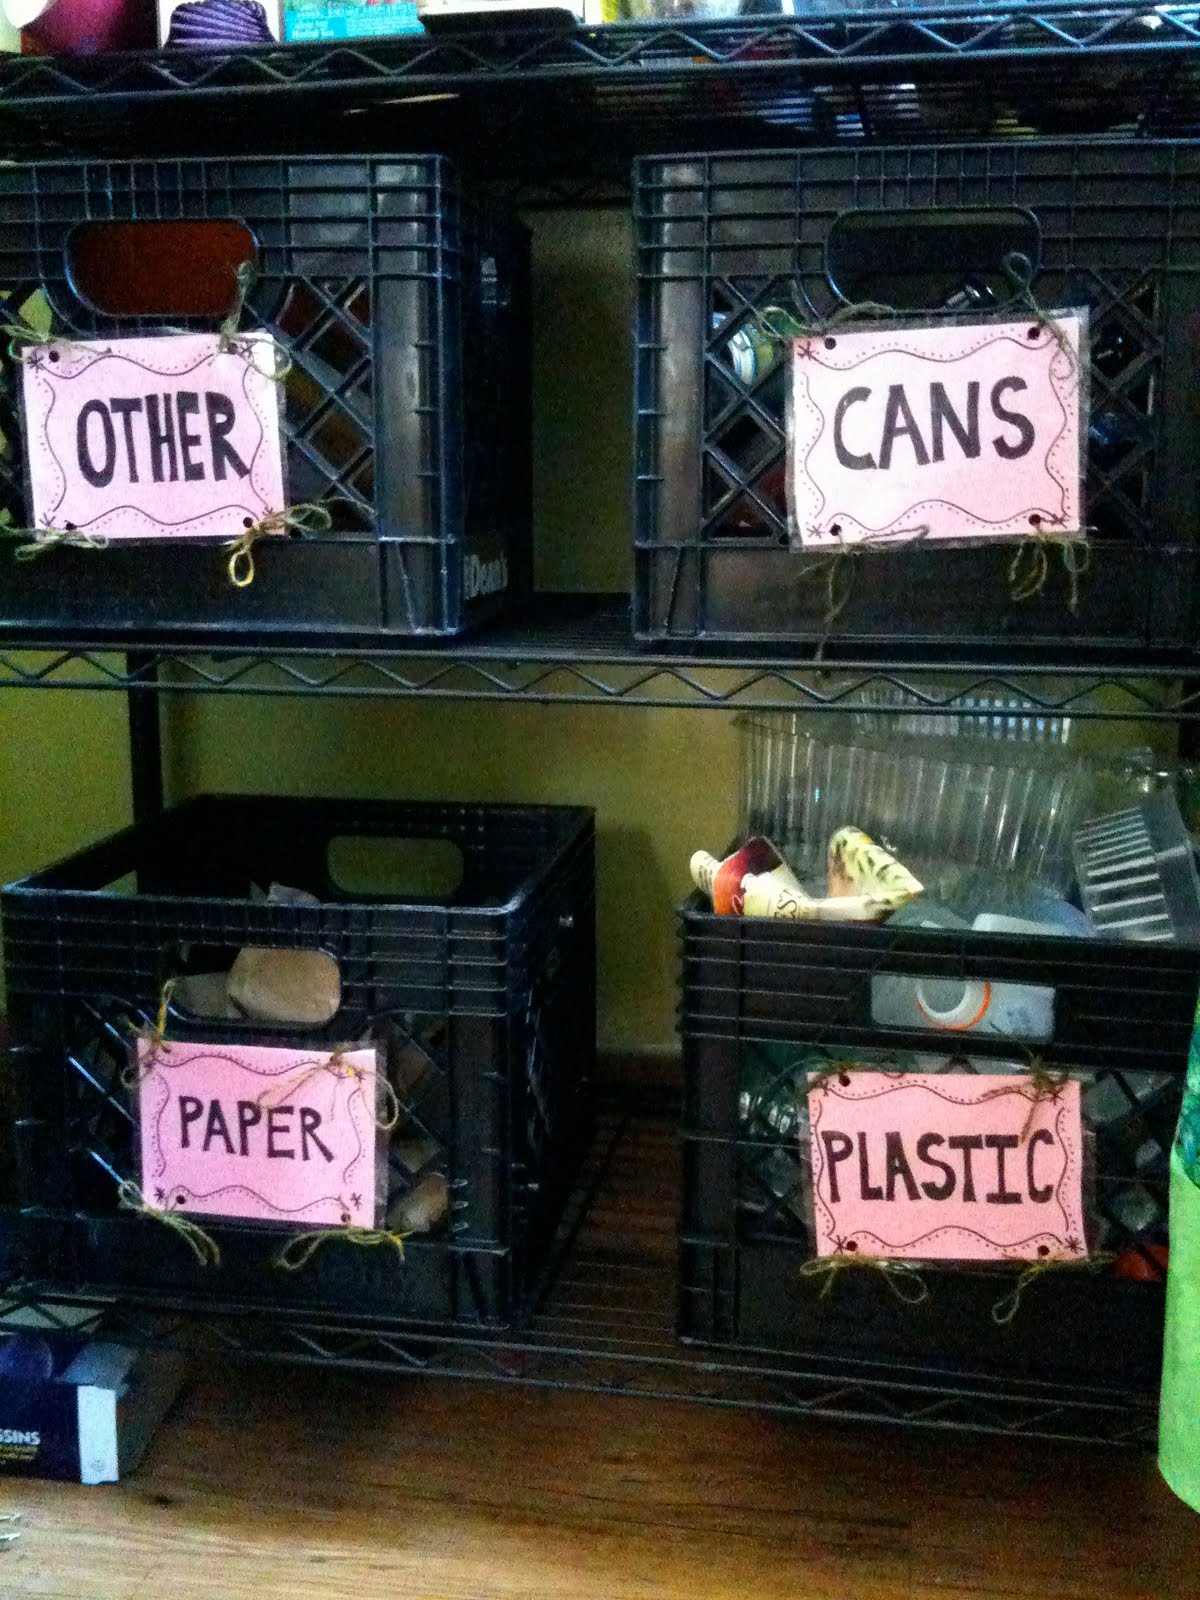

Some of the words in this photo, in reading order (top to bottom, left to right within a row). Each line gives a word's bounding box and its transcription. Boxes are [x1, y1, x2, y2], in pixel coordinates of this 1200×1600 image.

[77, 391, 252, 488] OTHER
[833, 376, 1036, 470] CANS
[178, 1095, 334, 1162] PAPER
[821, 1128, 1055, 1205] PLASTIC
